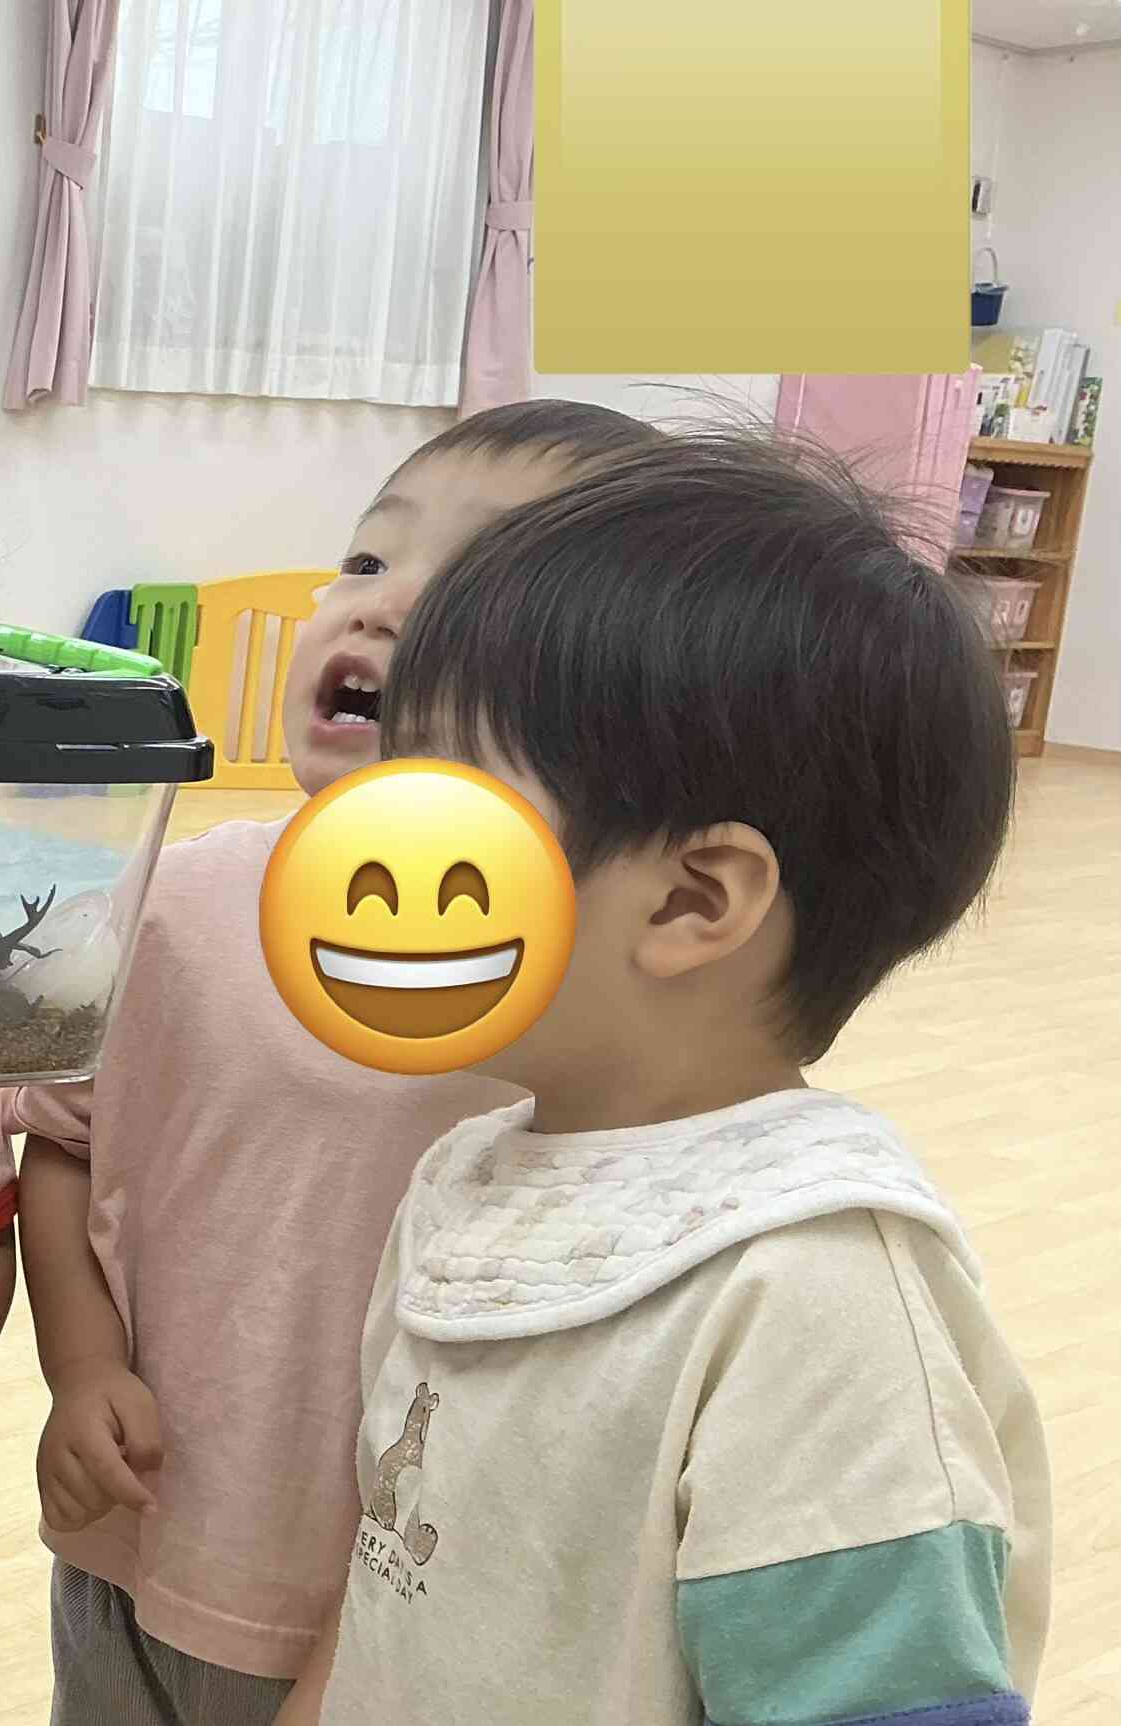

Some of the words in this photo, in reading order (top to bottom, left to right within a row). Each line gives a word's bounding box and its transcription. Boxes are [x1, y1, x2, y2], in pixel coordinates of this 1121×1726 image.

[356, 1546, 395, 1586] PECIAL
[360, 1531, 387, 1555] ERY
[416, 1580, 428, 1596] A
